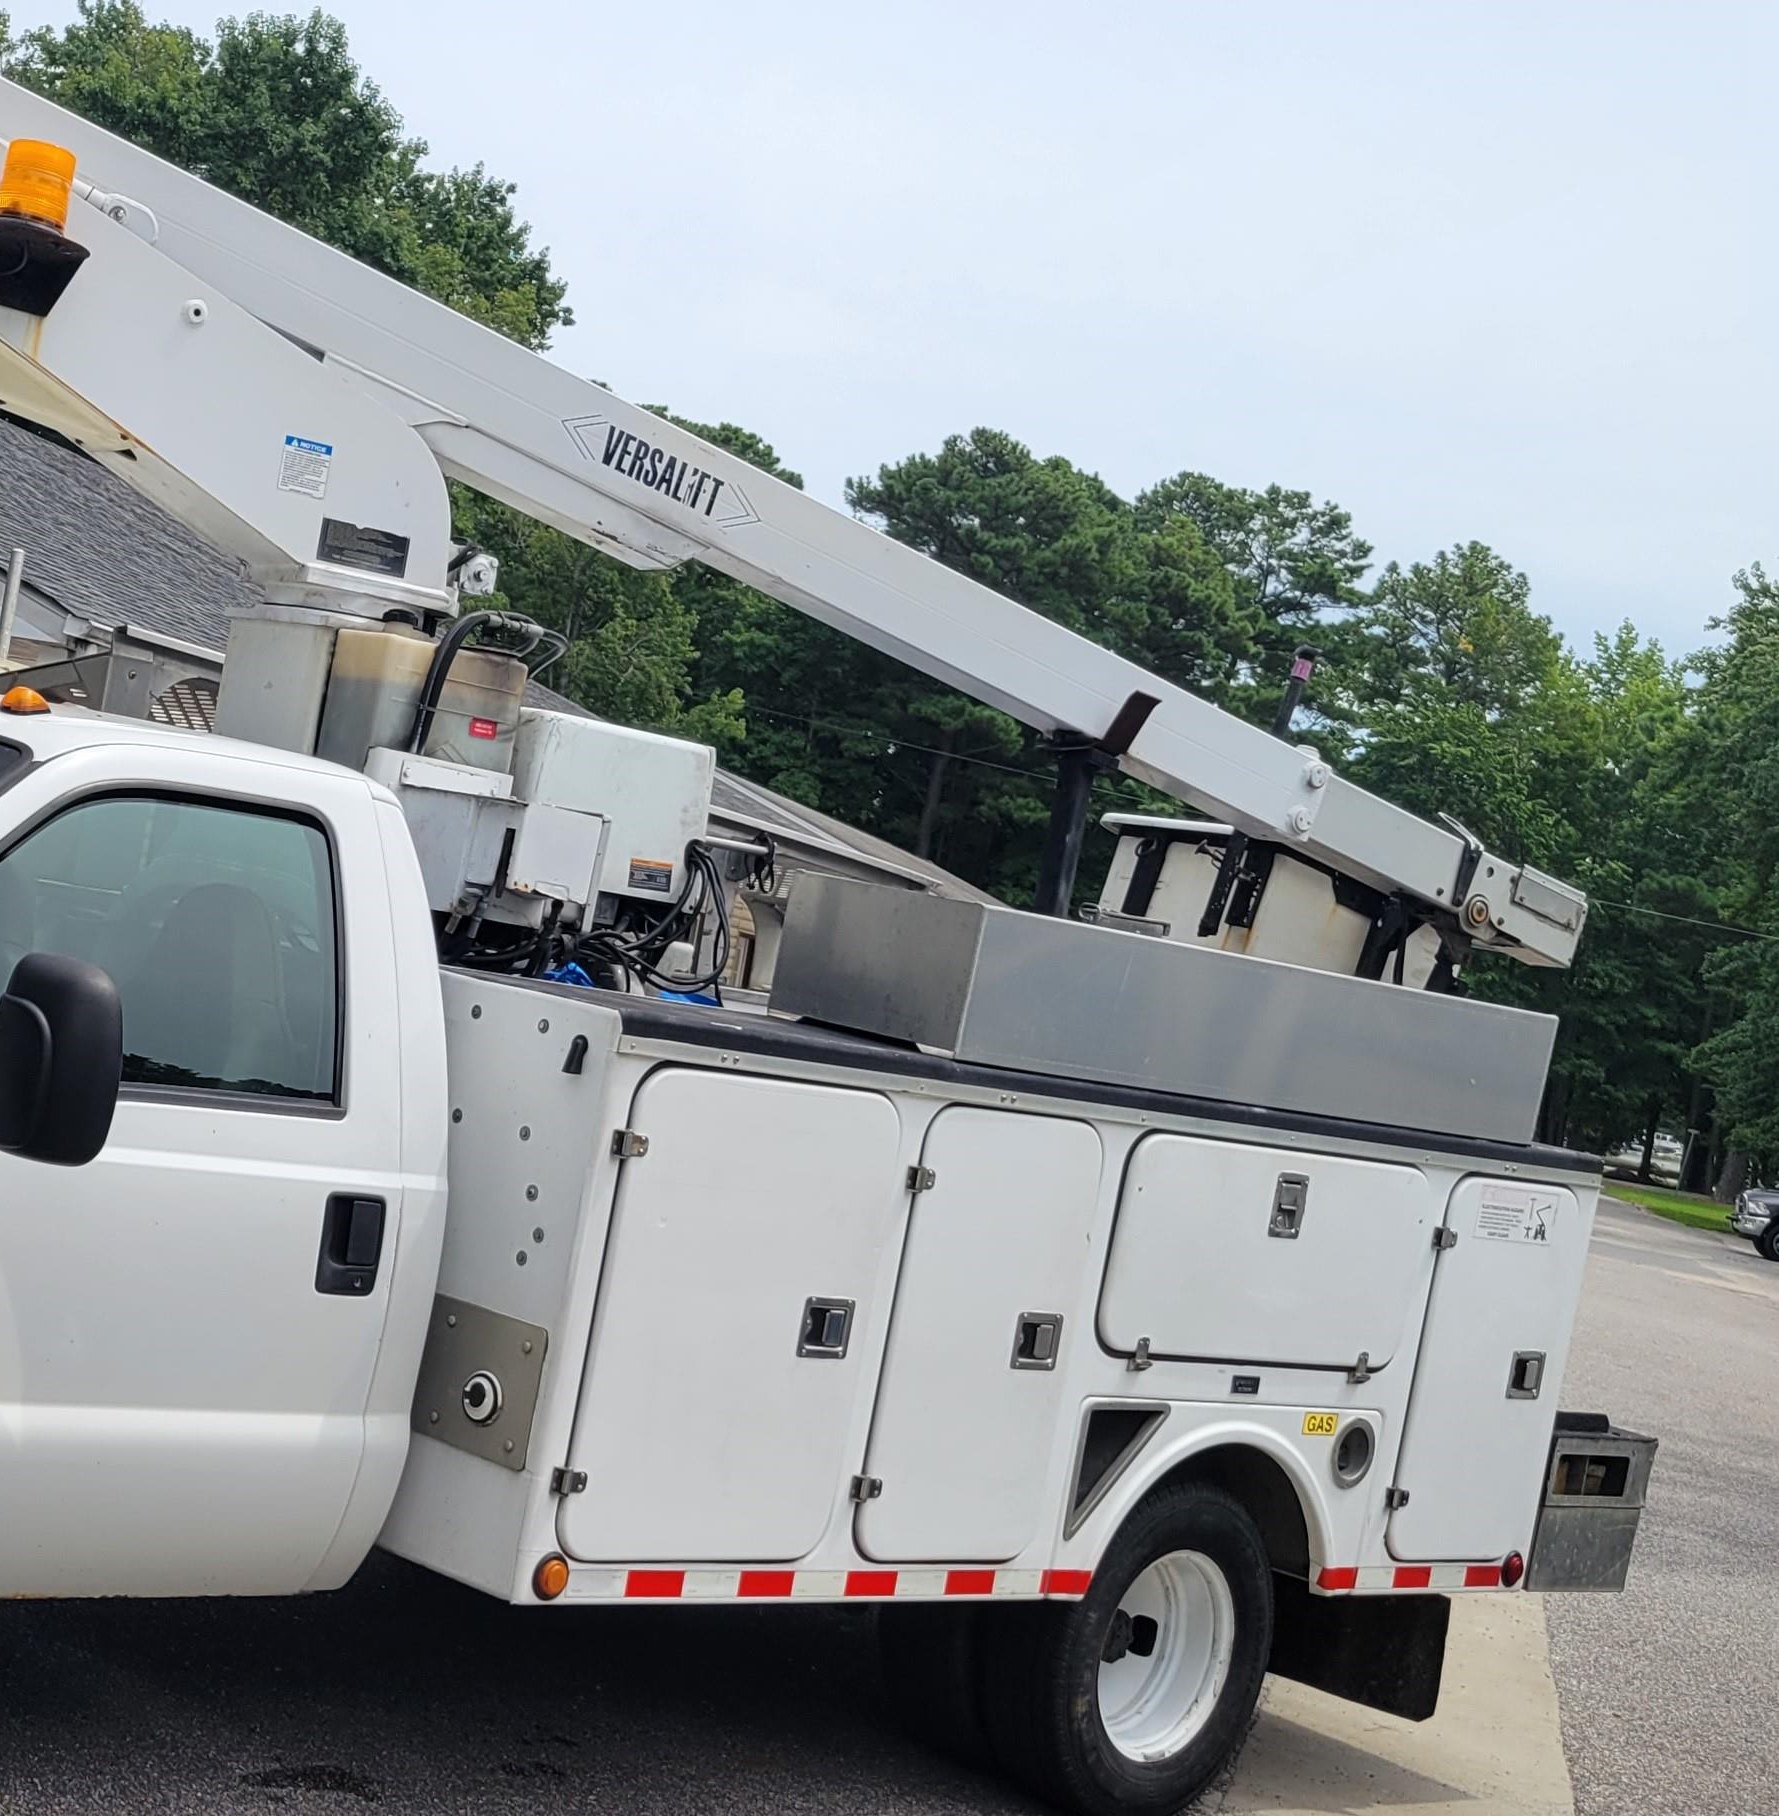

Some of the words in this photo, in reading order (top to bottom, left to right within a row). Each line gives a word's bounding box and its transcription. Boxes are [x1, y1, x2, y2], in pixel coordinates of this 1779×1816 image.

[300, 441, 327, 453] NOTICE
[601, 424, 725, 517] VERSALIFT
[1307, 1415, 1334, 1433] GAS
